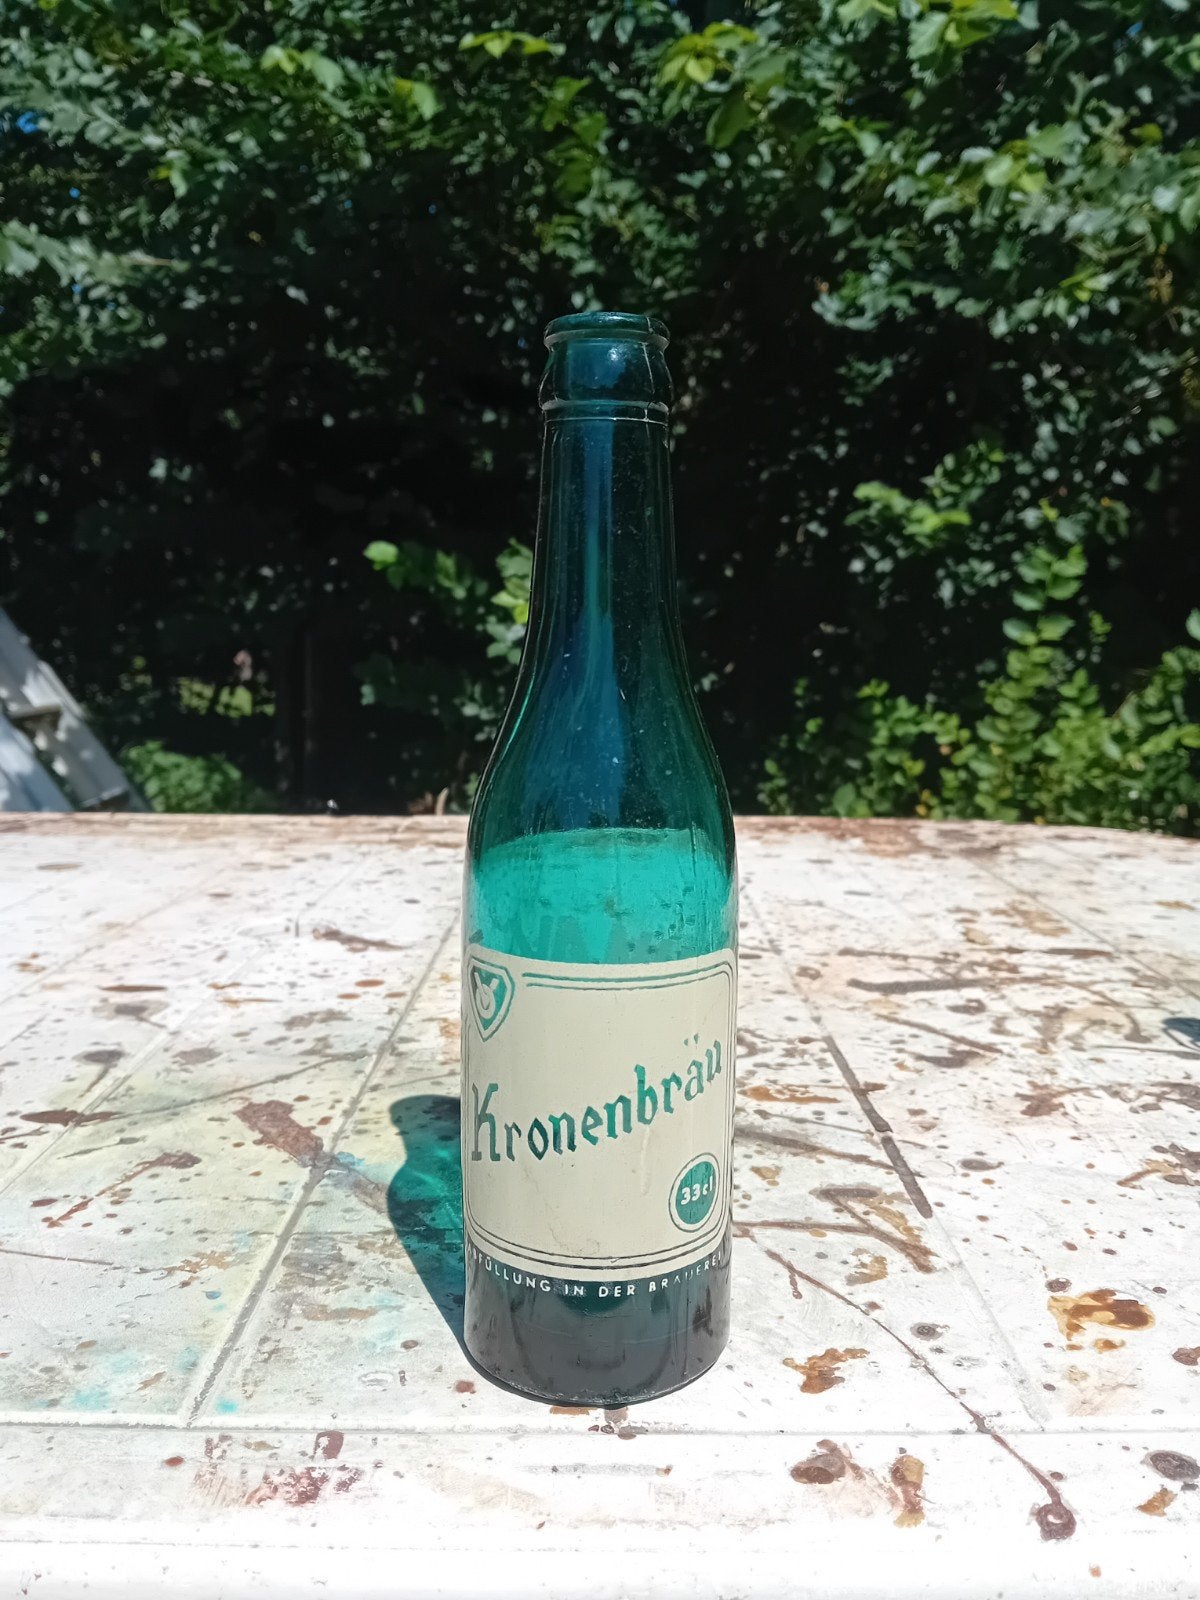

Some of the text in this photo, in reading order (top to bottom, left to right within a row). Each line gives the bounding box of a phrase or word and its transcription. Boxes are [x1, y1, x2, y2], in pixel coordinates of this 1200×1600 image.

[471, 1033, 722, 1162] Kronenbräu
[680, 1175, 713, 1206] 33cl
[564, 1283, 584, 1296] IN
[598, 1284, 636, 1298] DER
[648, 1251, 721, 1293] BRAUEREI
